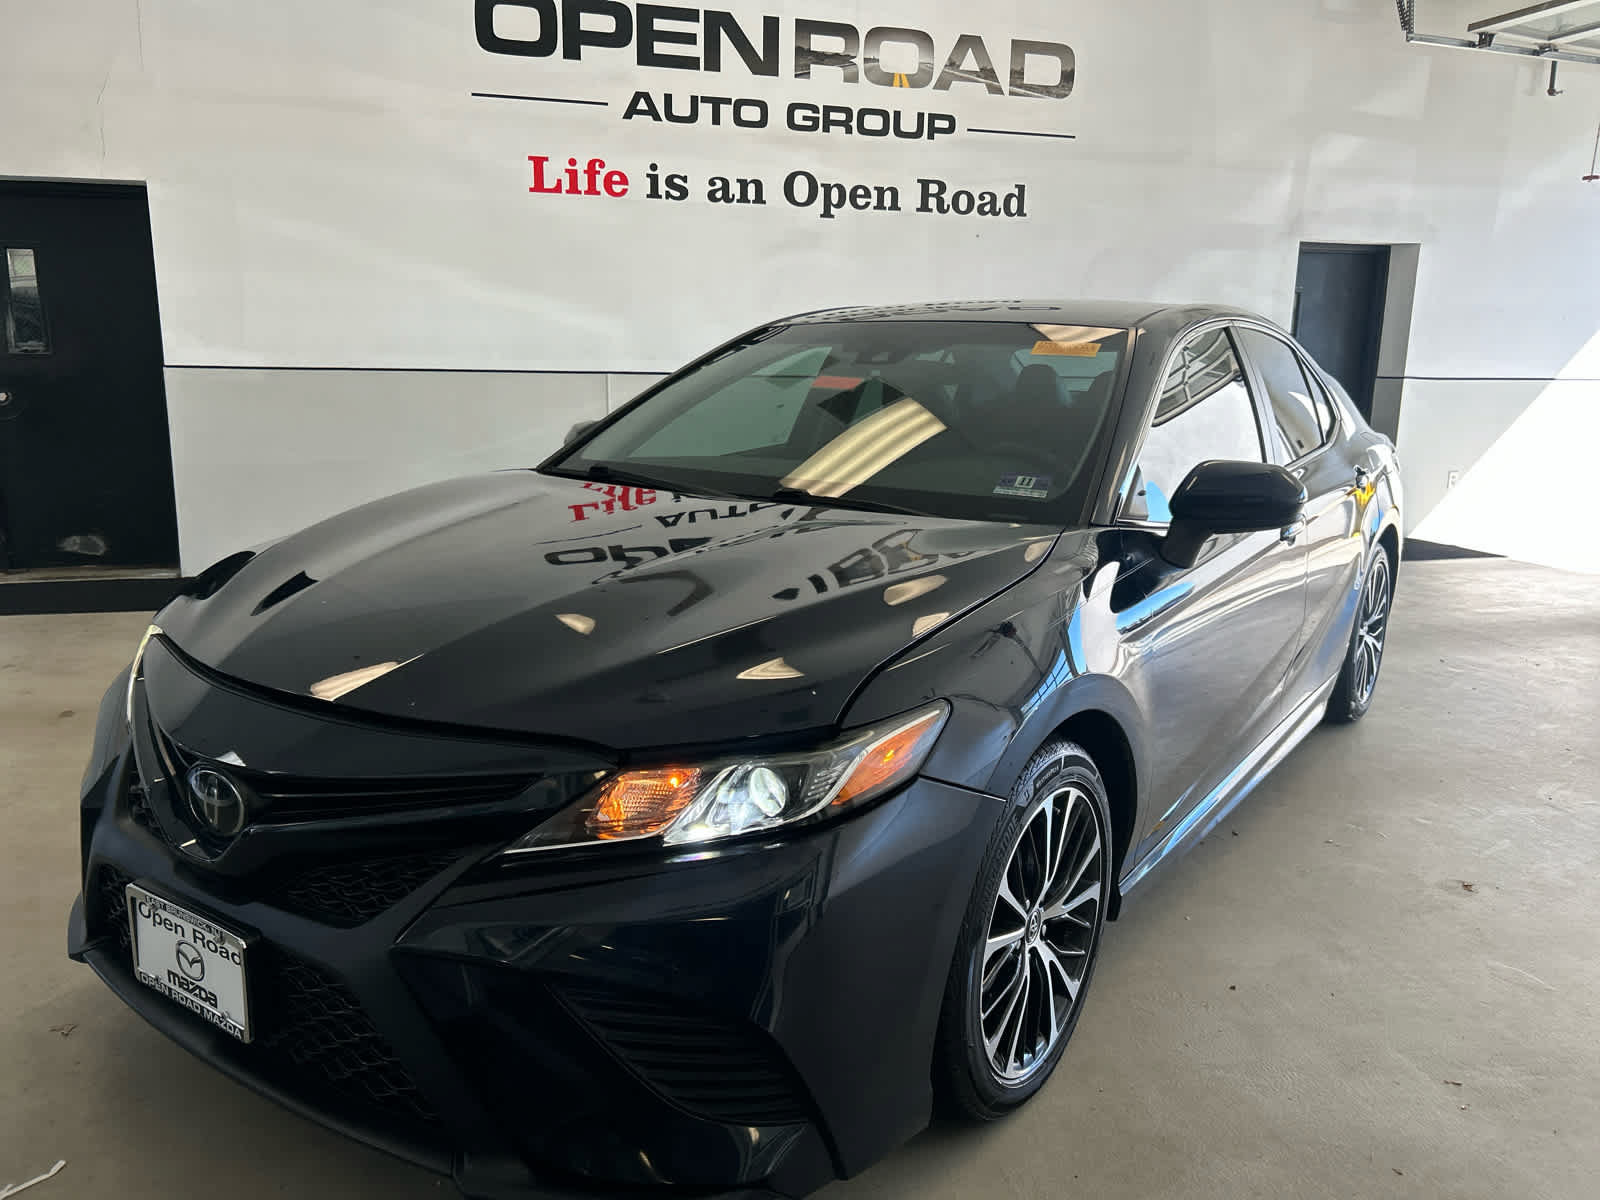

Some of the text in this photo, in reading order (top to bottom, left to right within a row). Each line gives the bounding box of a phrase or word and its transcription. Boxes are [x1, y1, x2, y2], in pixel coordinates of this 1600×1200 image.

[475, 0, 1076, 99] OPEN ROAD
[622, 91, 956, 140] AUTO GROUP
[527, 155, 1027, 218] Life is an Open Road
[138, 901, 185, 937] Open
[139, 971, 242, 1040] OPEN ROAD MAZDA
[167, 969, 218, 1008] mazda
